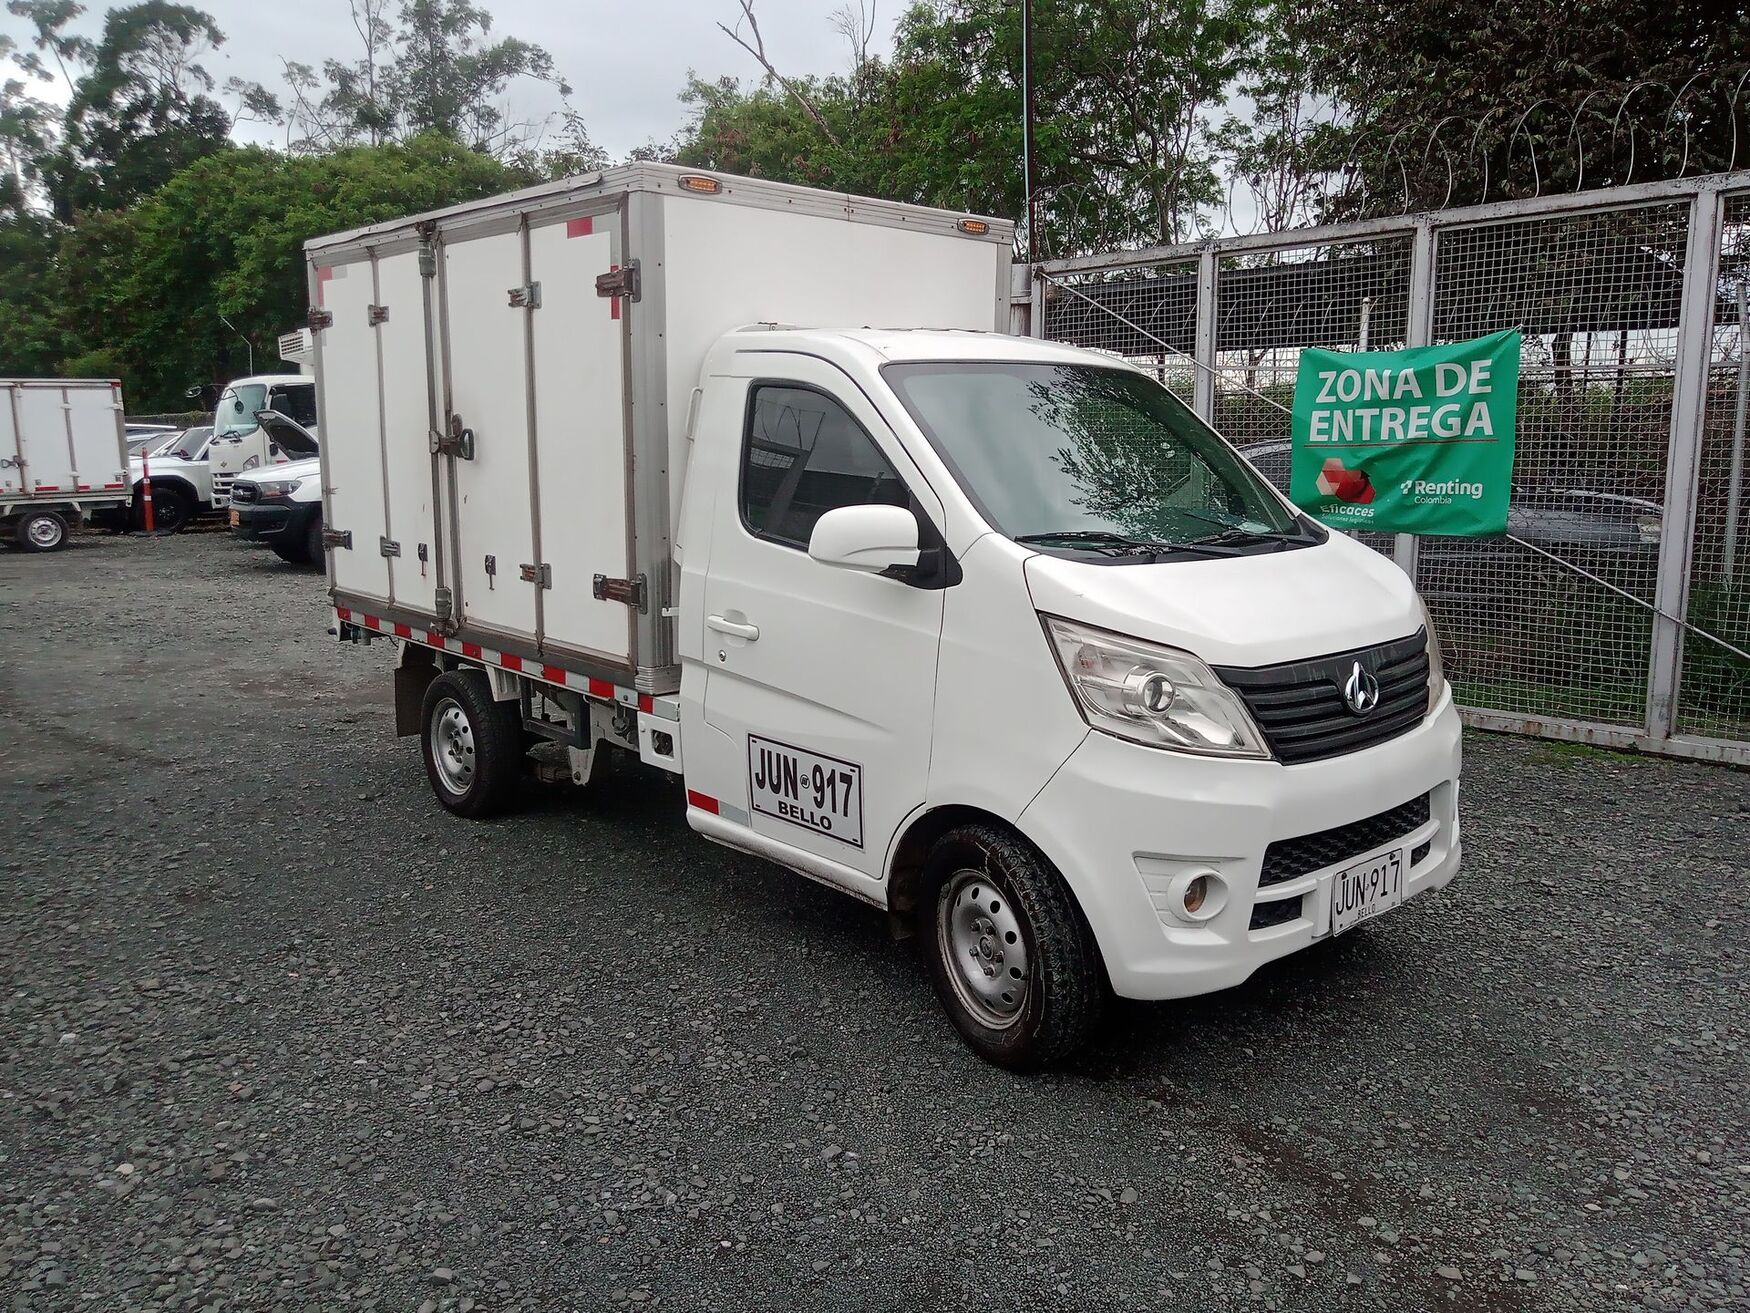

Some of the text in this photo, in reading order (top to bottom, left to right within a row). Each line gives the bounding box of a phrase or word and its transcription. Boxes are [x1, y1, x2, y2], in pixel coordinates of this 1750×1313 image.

[1315, 358, 1493, 404] ZONA DE
[1309, 401, 1494, 442] ENTREGA
[1414, 478, 1483, 499] Renting
[1414, 496, 1452, 504] Colombia
[1320, 503, 1375, 517] Eficaces
[755, 747, 853, 818] JUN 917
[777, 800, 832, 831] BELLO
